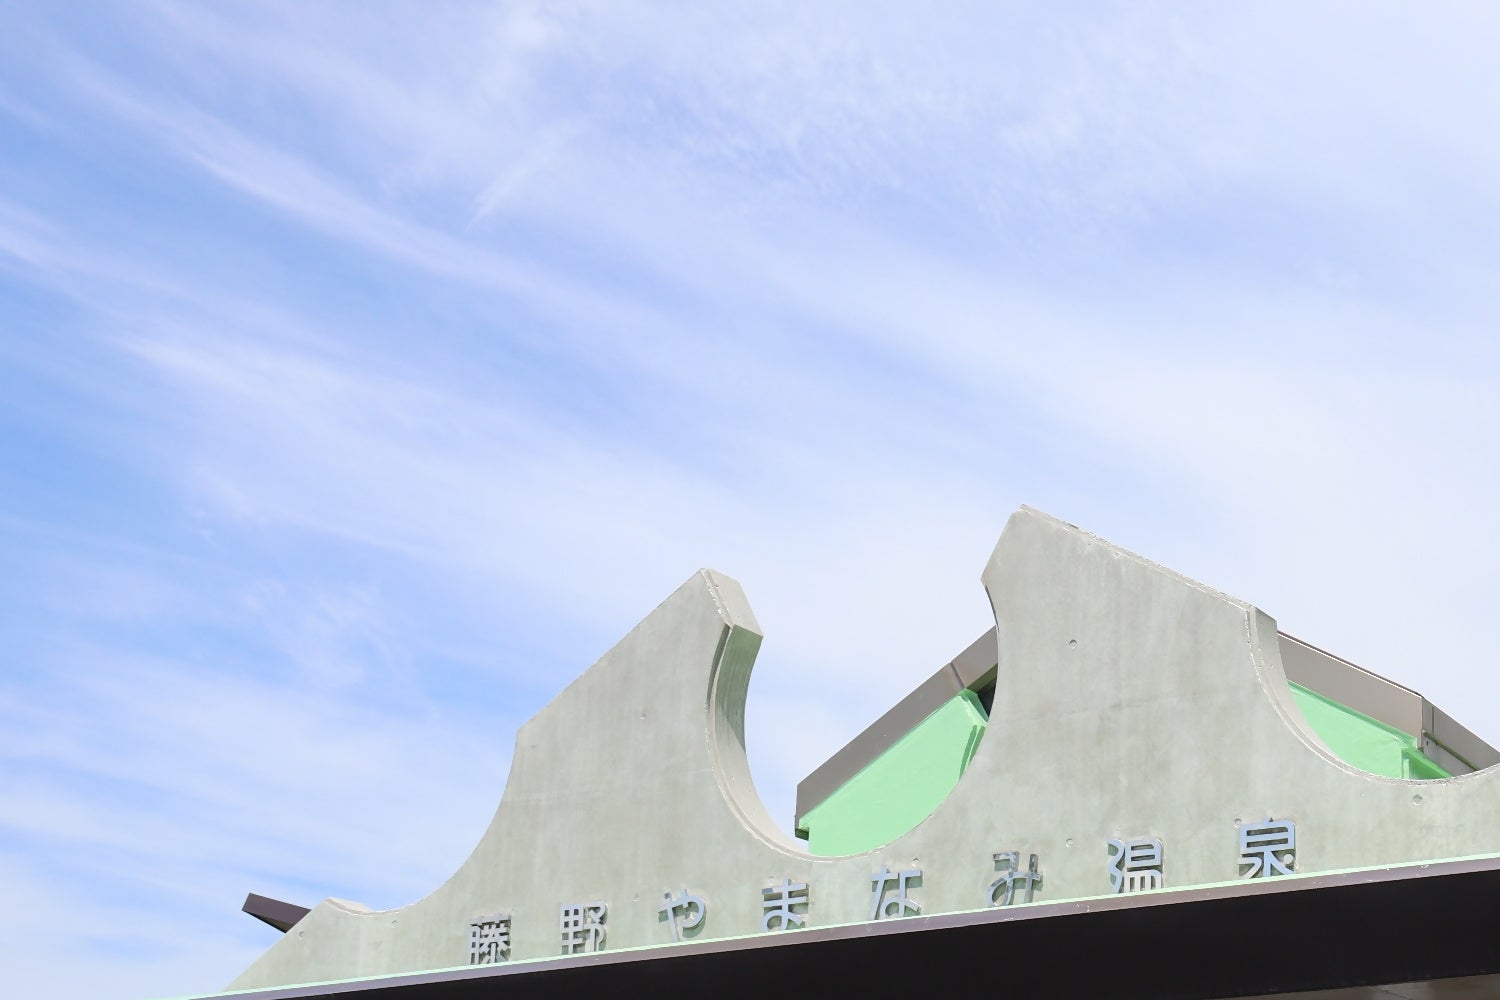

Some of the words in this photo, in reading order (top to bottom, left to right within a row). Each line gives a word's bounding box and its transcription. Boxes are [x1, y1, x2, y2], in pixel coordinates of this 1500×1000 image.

[467, 816, 1297, 966] 藤野やまなみ温泉
